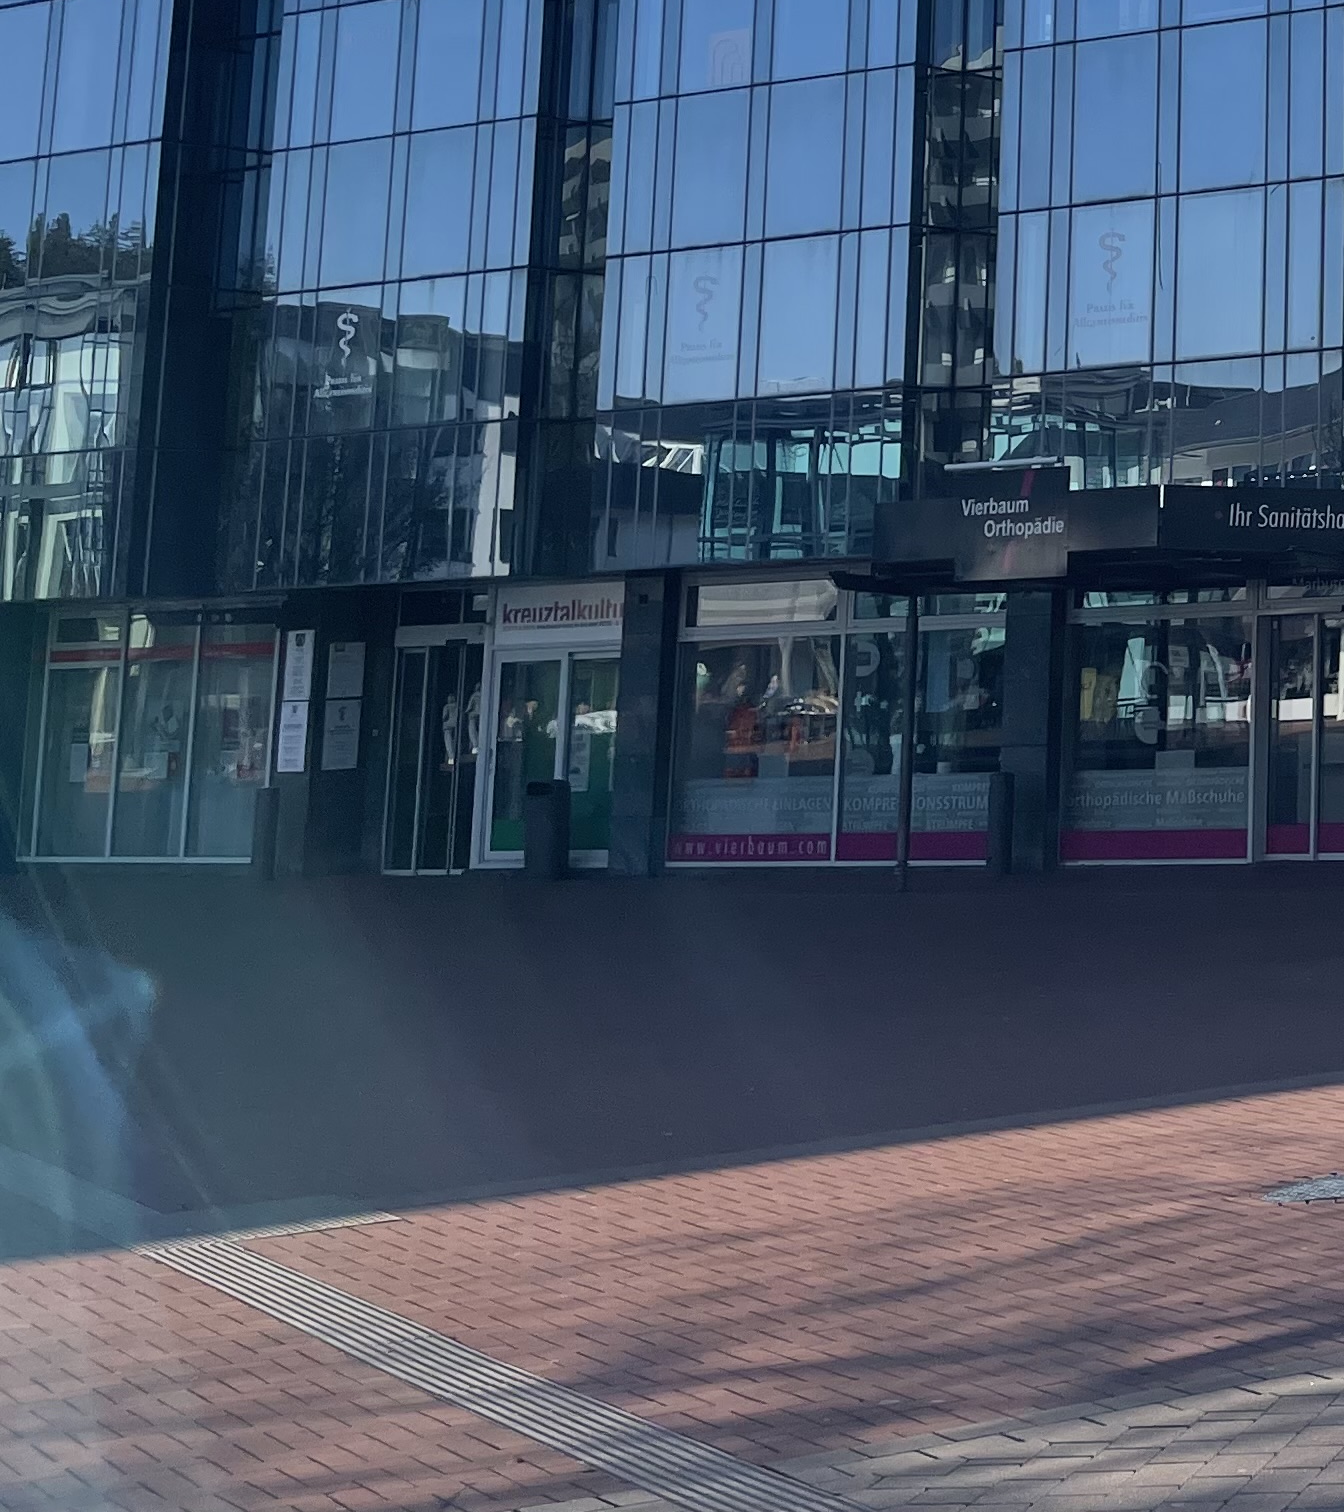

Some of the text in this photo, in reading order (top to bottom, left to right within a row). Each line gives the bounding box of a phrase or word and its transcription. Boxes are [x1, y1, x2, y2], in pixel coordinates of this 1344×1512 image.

[961, 497, 1029, 516] Vierbaum
[1229, 502, 1253, 527] Ihr
[983, 516, 1065, 539] Orthopädie
[502, 597, 624, 624] kreuztalkultu
[674, 836, 828, 855] www.vierbaum.com
